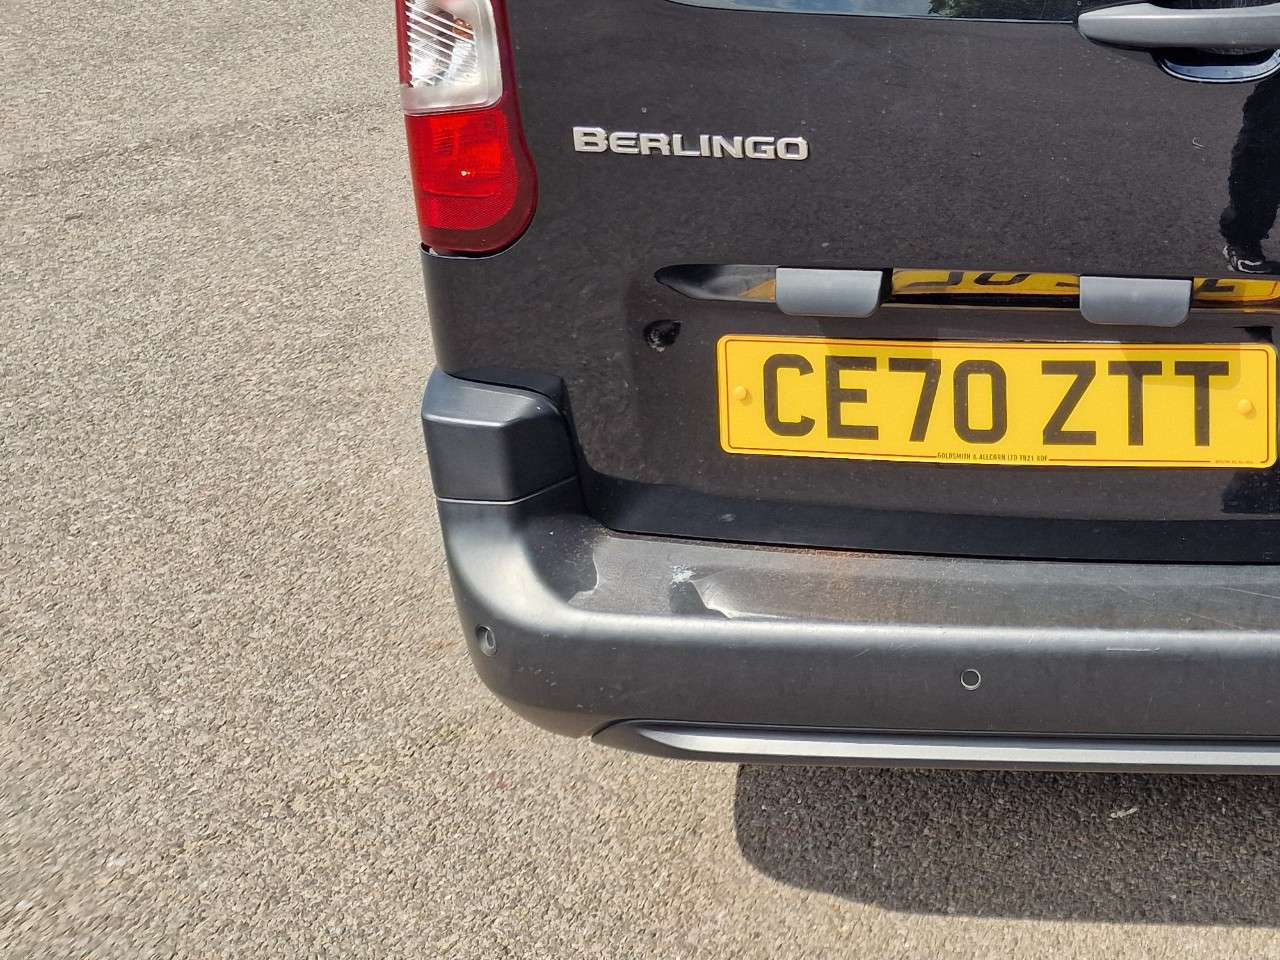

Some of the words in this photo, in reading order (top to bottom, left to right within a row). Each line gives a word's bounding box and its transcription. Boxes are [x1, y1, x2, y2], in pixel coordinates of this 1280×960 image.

[572, 126, 810, 161] BERLINGO
[762, 353, 1008, 445] CE70
[1041, 360, 1231, 447] ZTT
